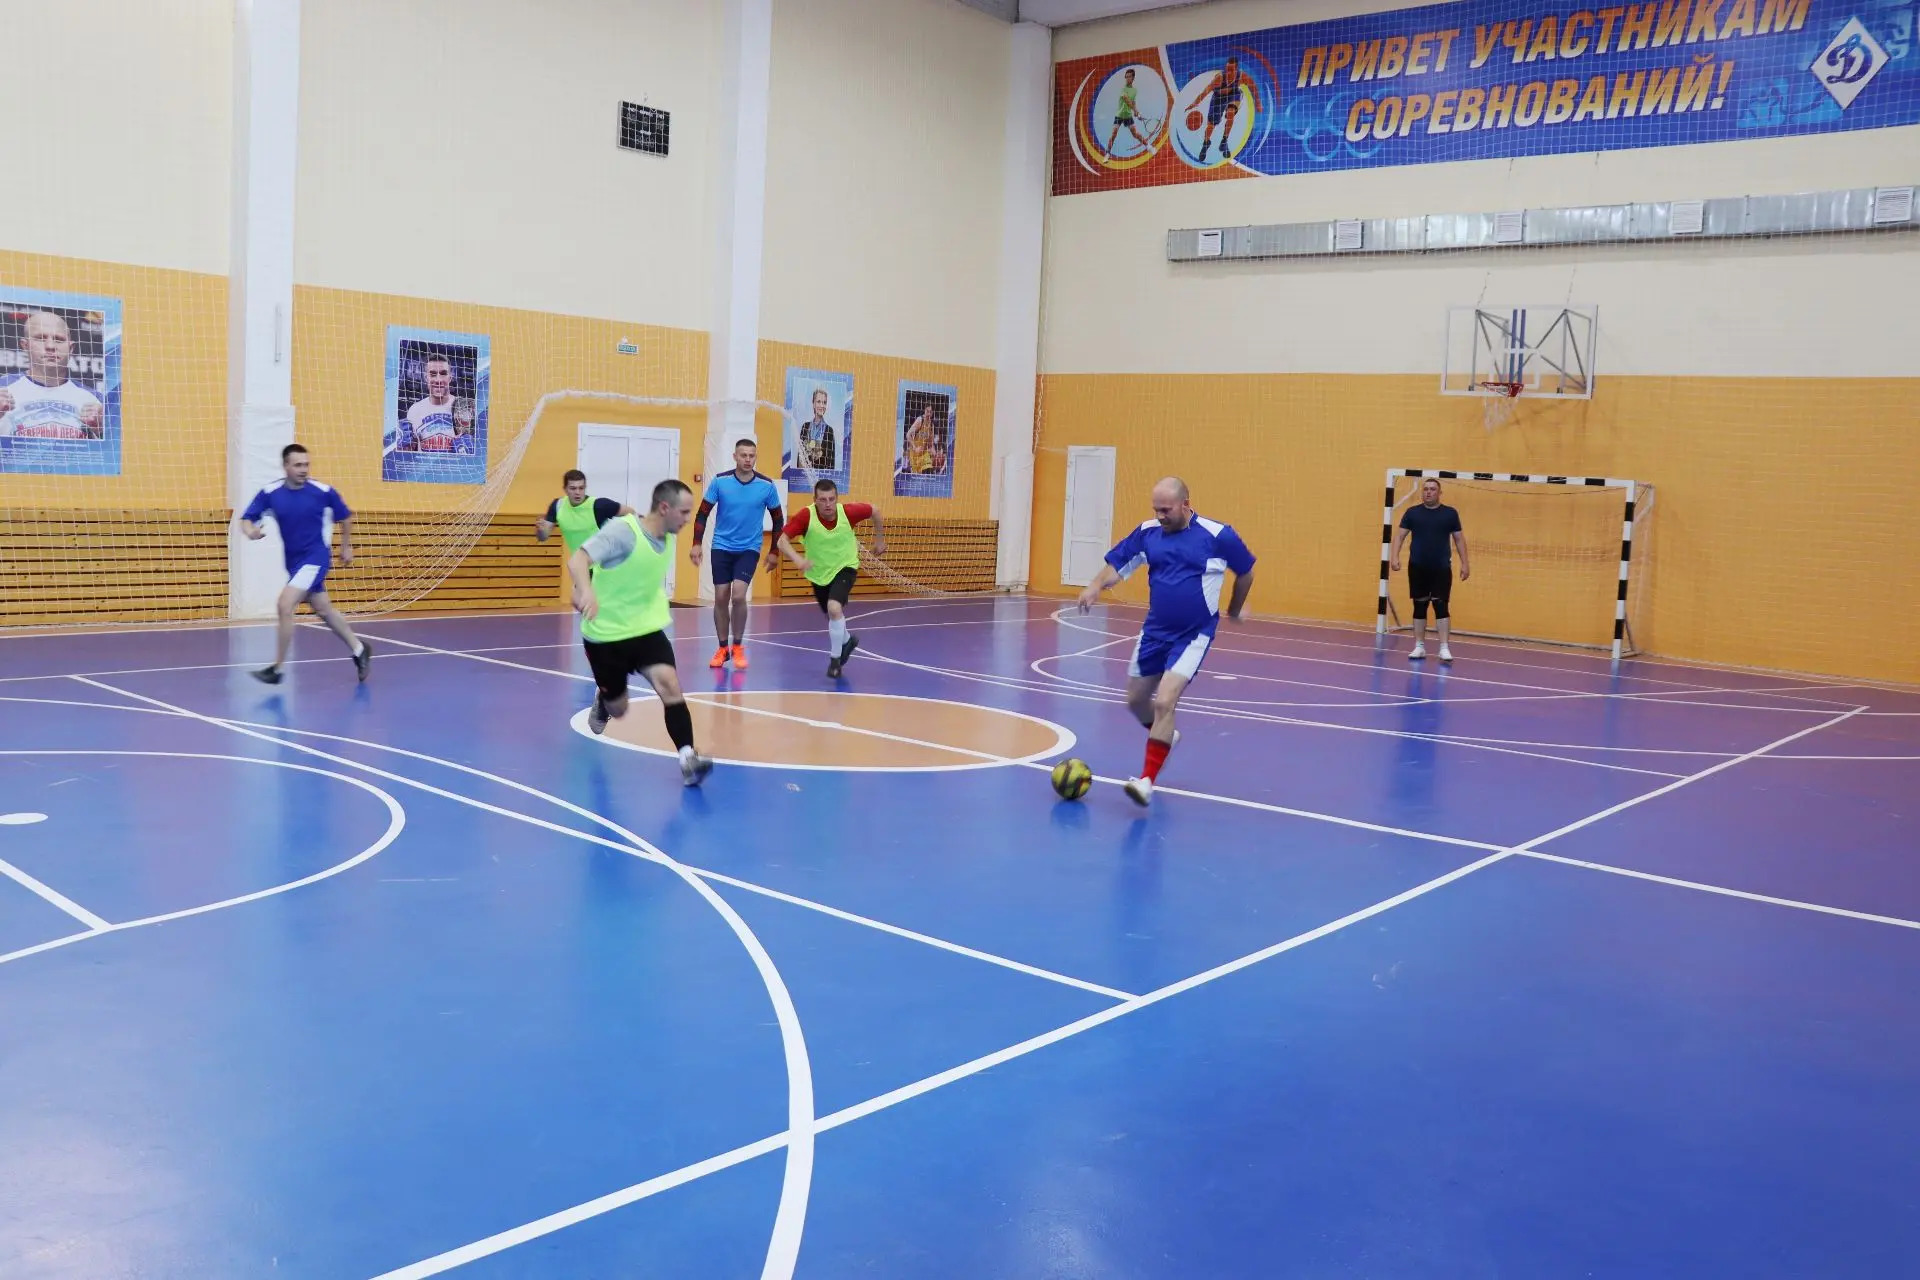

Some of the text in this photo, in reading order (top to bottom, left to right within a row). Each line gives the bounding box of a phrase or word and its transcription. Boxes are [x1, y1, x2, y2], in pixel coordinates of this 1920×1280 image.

[1297, 0, 1811, 88] ПРИВЕТ УЧАСТНИКАМ
[1345, 53, 1735, 142] СОРЕВНОВАНИЙ!
